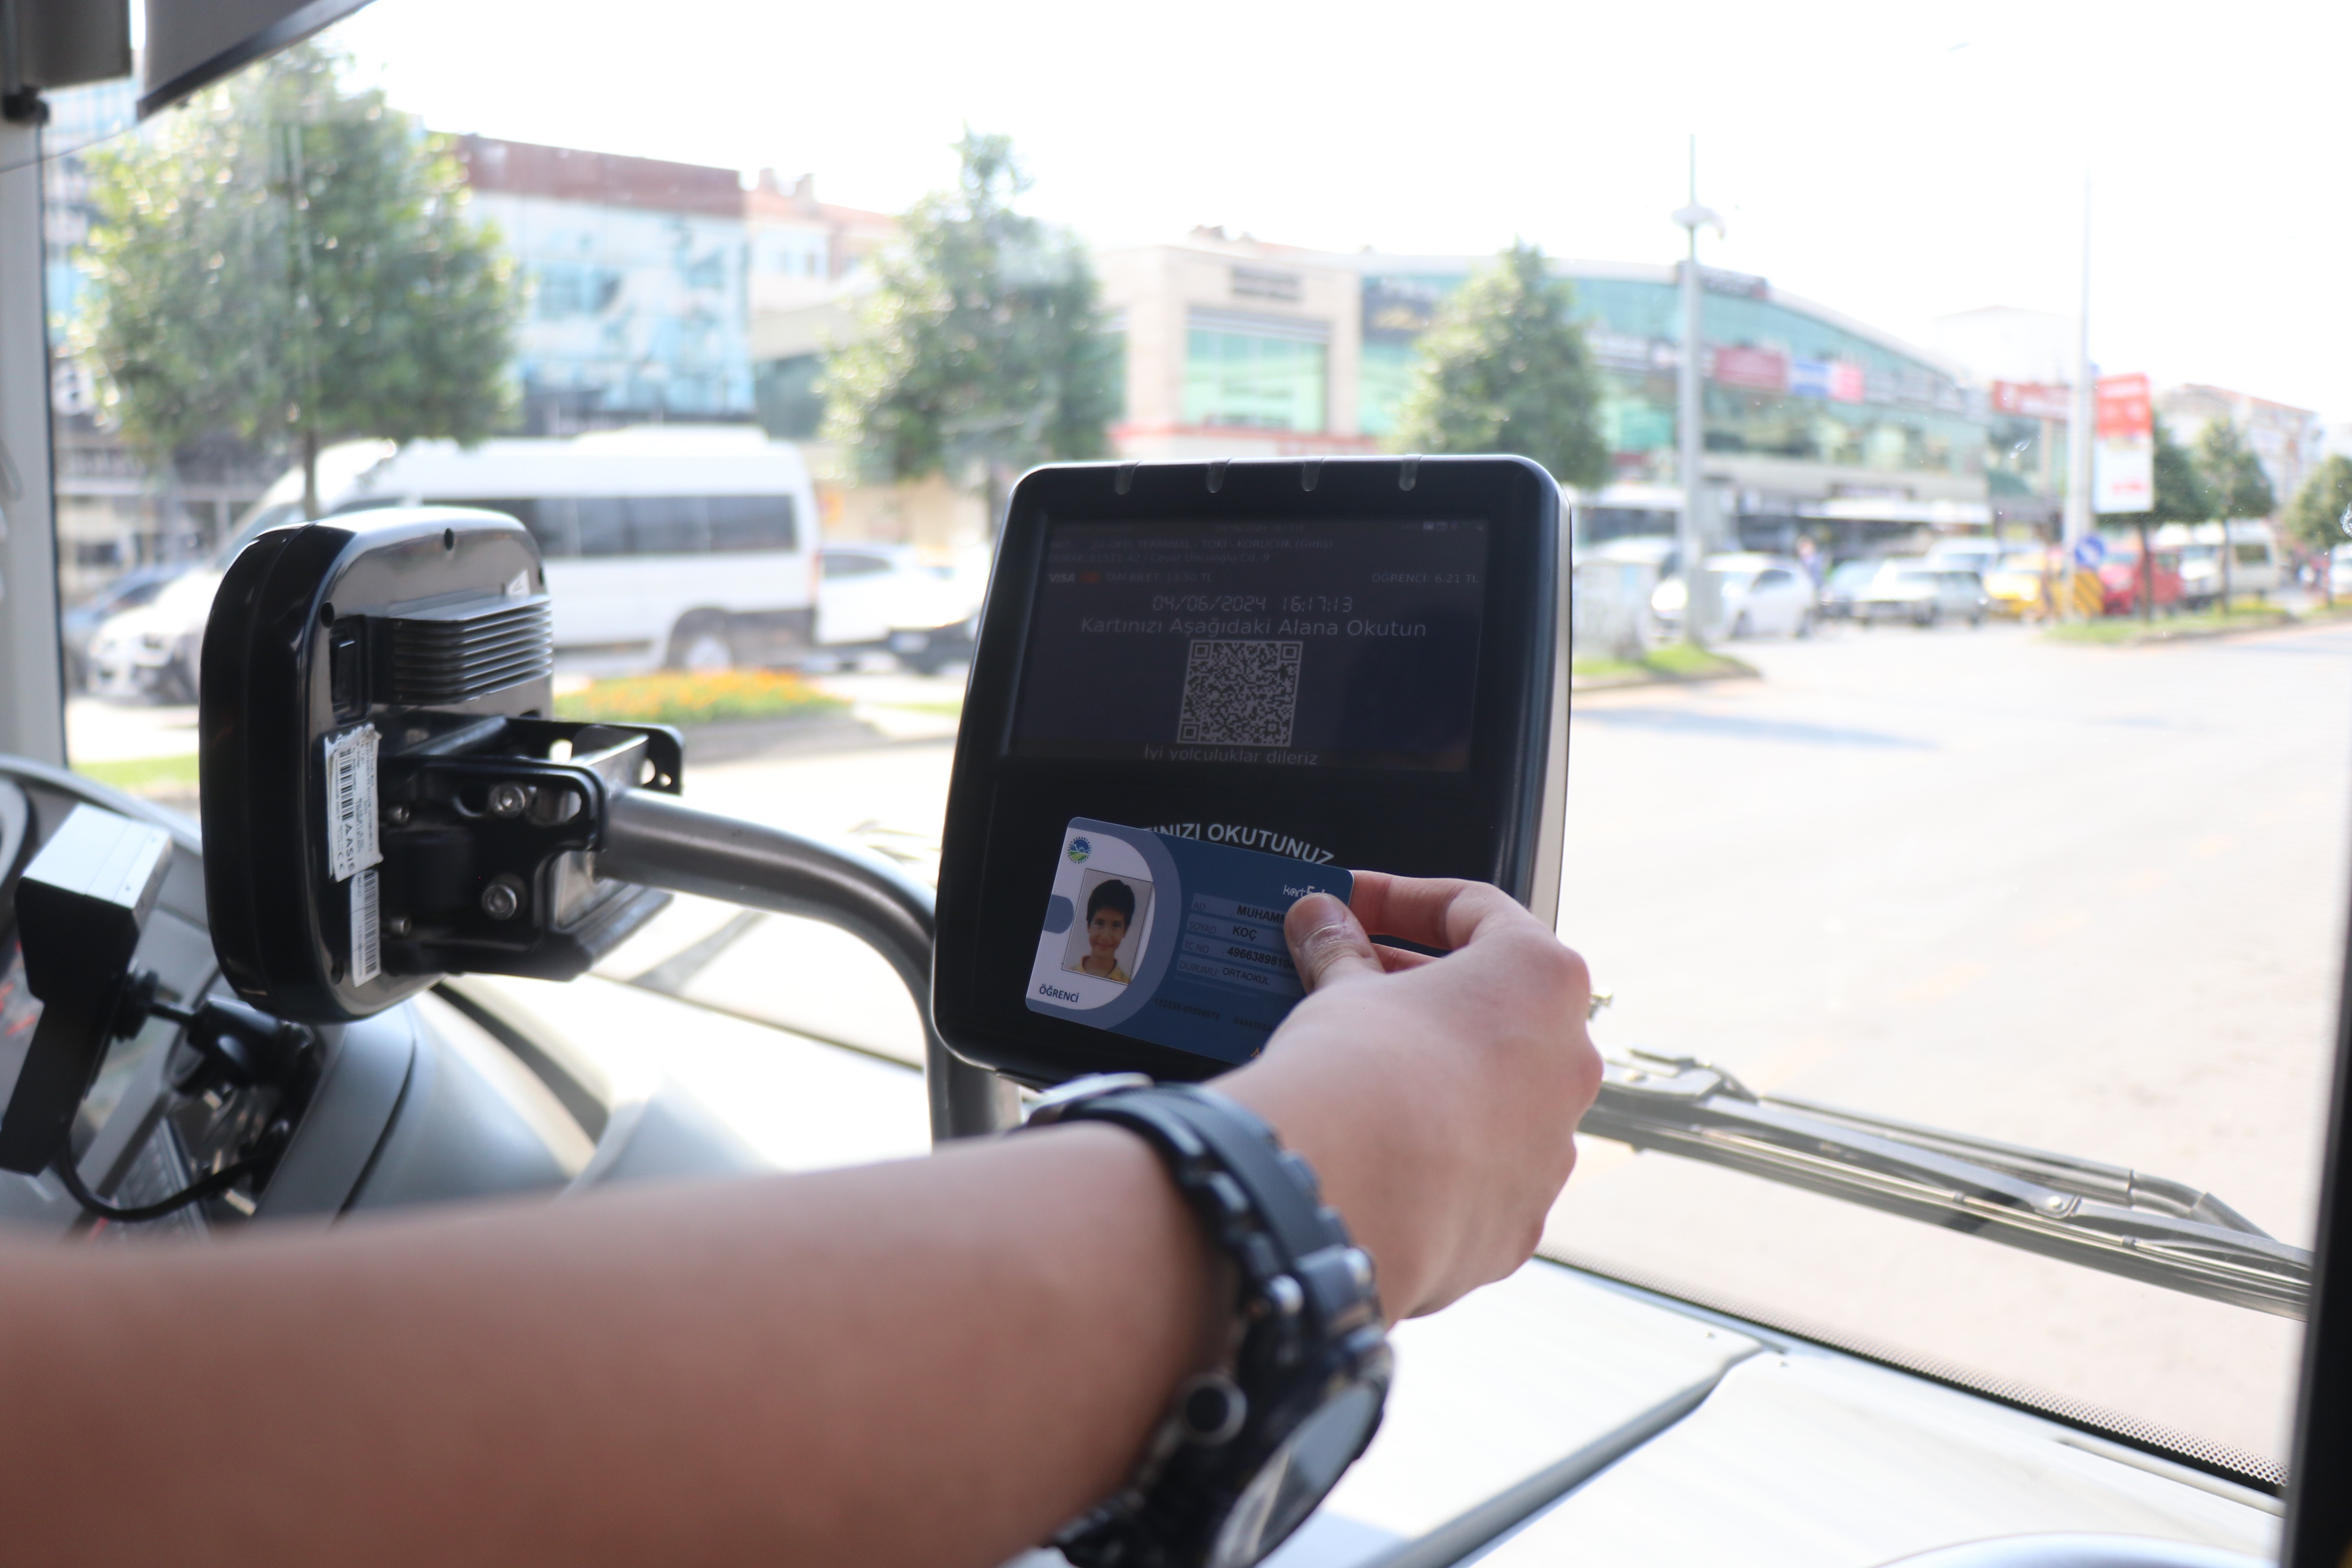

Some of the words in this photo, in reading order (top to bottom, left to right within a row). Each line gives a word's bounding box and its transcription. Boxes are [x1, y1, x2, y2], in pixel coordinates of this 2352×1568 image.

[1238, 539, 1292, 549] KORUCUK
[1296, 539, 1334, 550] (Gidiş)
[1151, 553, 1181, 563] Cevat
[1049, 573, 1075, 583] VISA
[1106, 573, 1127, 582] TAM
[1167, 573, 1197, 583] 13.50
[1201, 573, 1213, 583] TL
[1435, 573, 1460, 584] 6.21
[1466, 574, 1479, 584] TL
[1152, 595, 1267, 612] 04/06/2024
[1283, 596, 1353, 613] 16:17:13
[1081, 618, 1162, 633] Kartınızı
[1169, 617, 1271, 637] Aşağıdaki
[1277, 619, 1339, 635] Alana
[1347, 619, 1426, 637] Okutun
[1170, 747, 1262, 763] yolculuklar
[1267, 750, 1319, 765] dileriz
[1208, 823, 1335, 865] OKUTUNUZ
[1194, 902, 1206, 911] AD
[1189, 921, 1217, 934] SOYAD
[1233, 926, 1257, 941] KOÇ
[1185, 941, 1195, 950] TC
[1196, 943, 1209, 954] NO
[1223, 967, 1270, 985] ORTAOKUL
[1039, 983, 1079, 1003] ÖĞRENCİ
